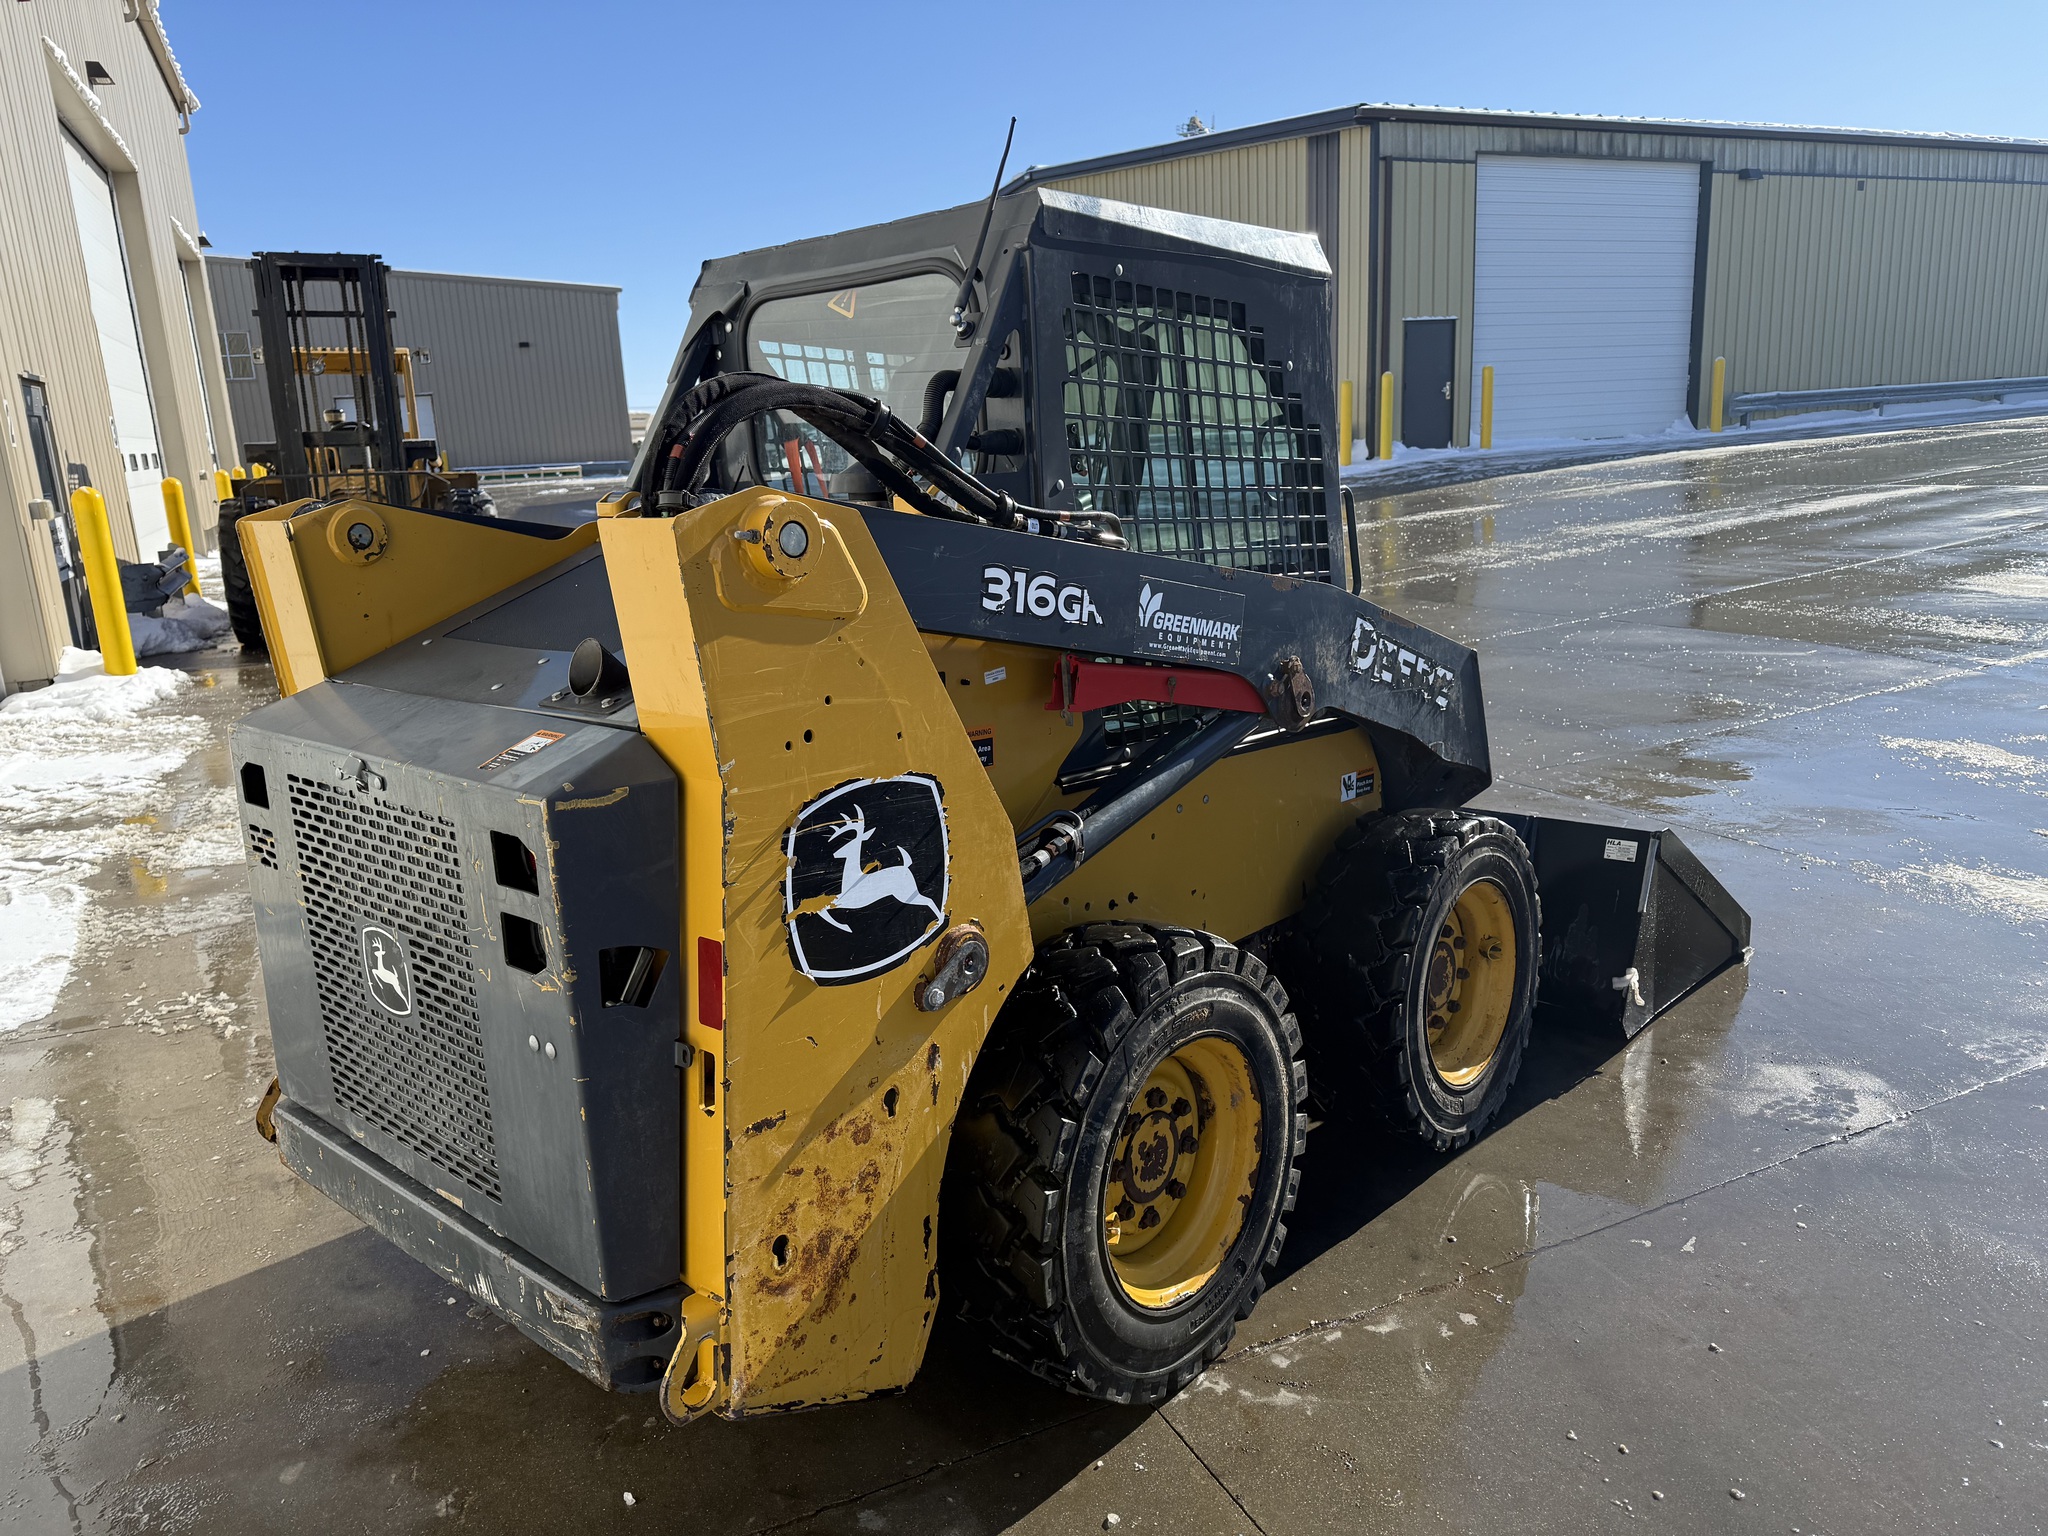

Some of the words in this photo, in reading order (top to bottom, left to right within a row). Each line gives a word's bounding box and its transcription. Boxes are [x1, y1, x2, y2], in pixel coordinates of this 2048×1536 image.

[1153, 611, 1241, 641] GREENMARK
[1158, 632, 1232, 650] EQUIPMENT
[977, 745, 991, 754] Area
